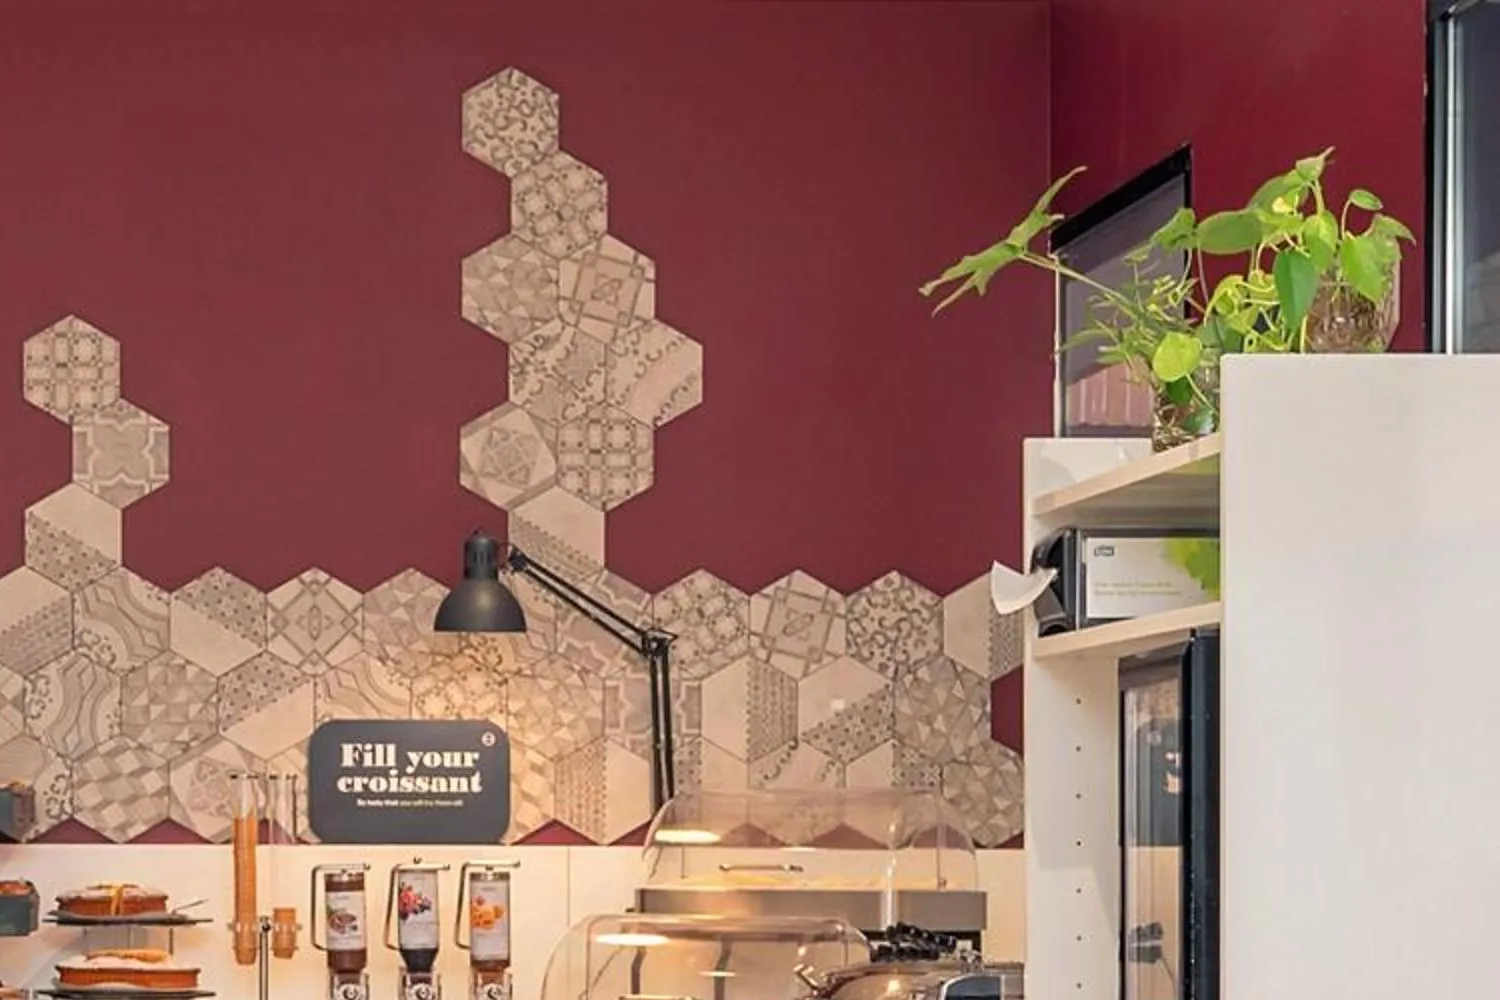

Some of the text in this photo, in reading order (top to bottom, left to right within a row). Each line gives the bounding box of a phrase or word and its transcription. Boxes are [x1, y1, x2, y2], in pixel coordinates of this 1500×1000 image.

[340, 743, 480, 775] Fill your
[336, 769, 483, 794] croissant
